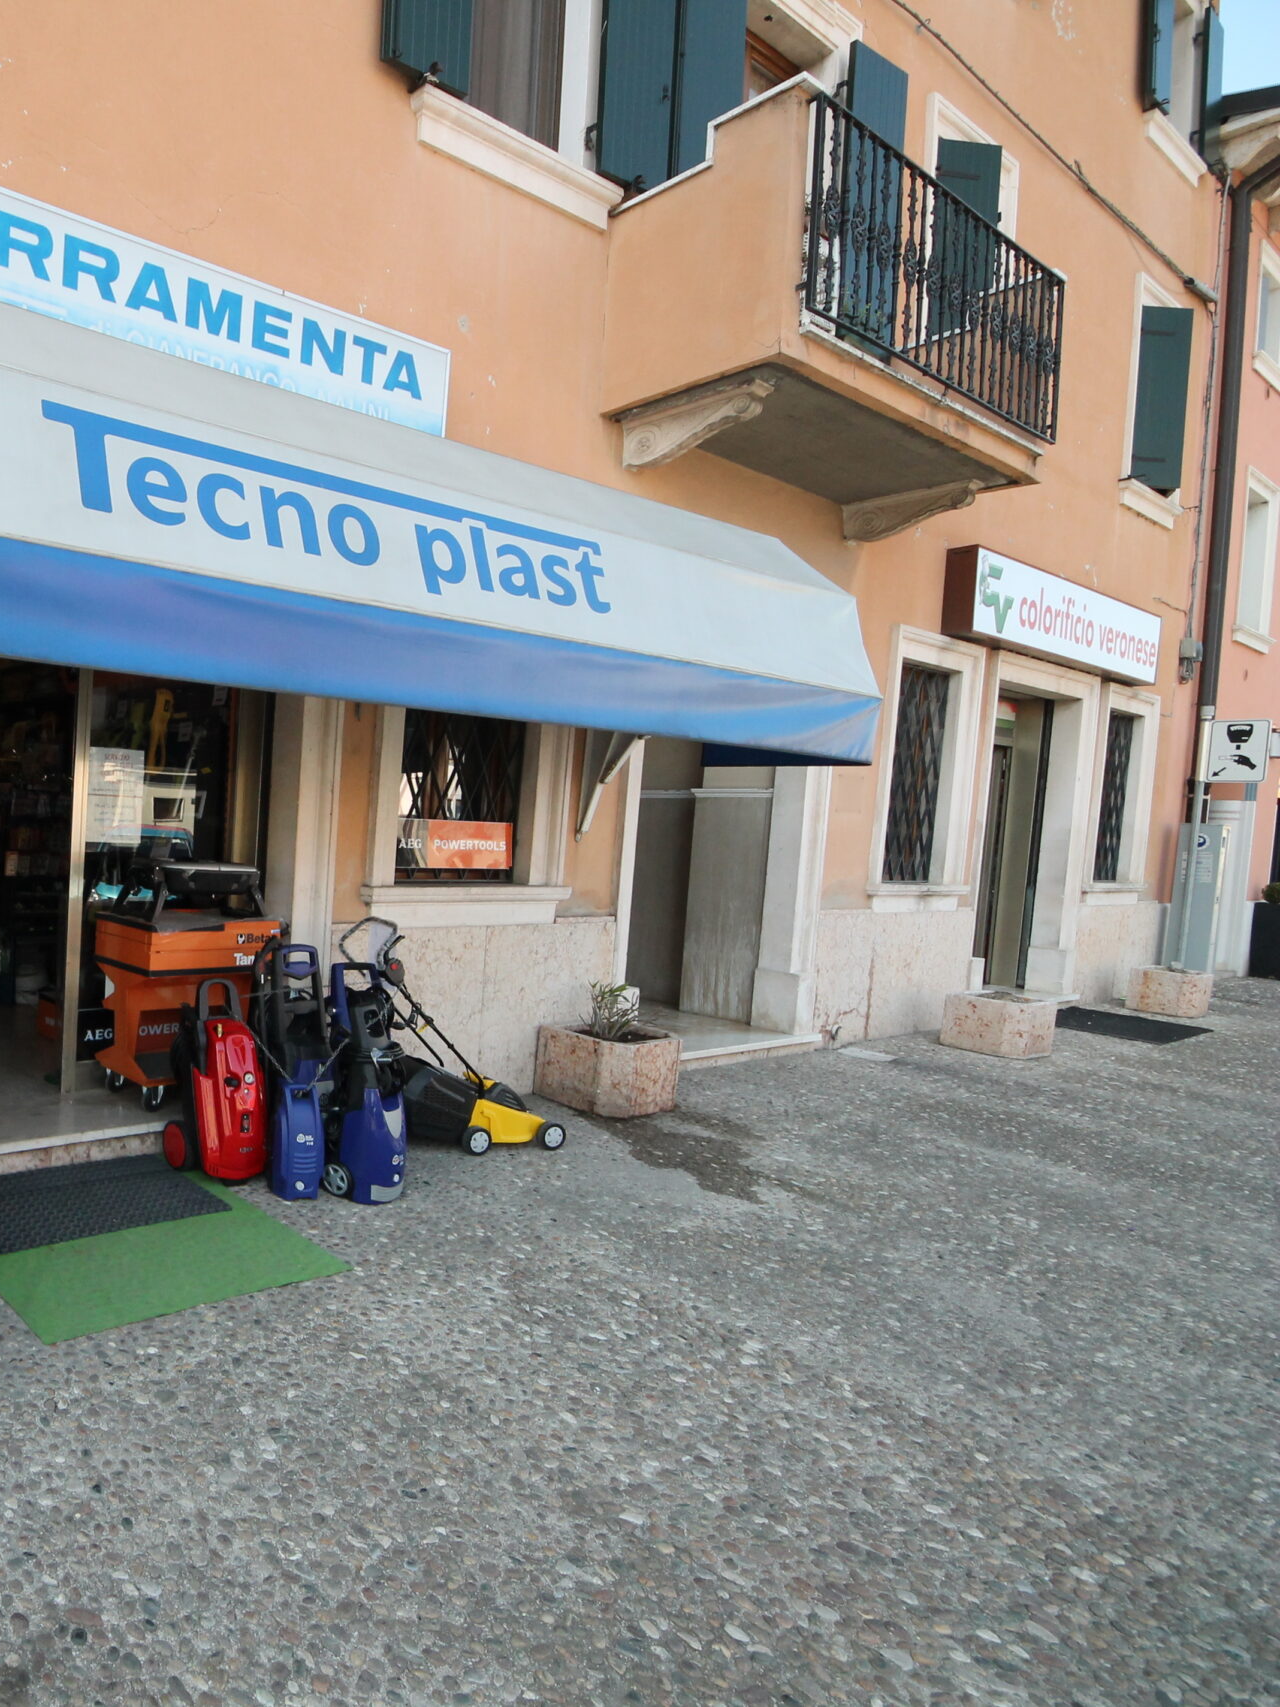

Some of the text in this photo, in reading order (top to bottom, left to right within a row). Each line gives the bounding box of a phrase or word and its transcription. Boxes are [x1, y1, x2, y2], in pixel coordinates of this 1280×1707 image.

[40, 399, 612, 615] Tecno plast
[1018, 587, 1157, 668] colorificio veronese
[398, 837, 507, 852] AEG POWERTOOLS
[246, 933, 272, 944] Beta
[84, 1027, 114, 1042] AEG
